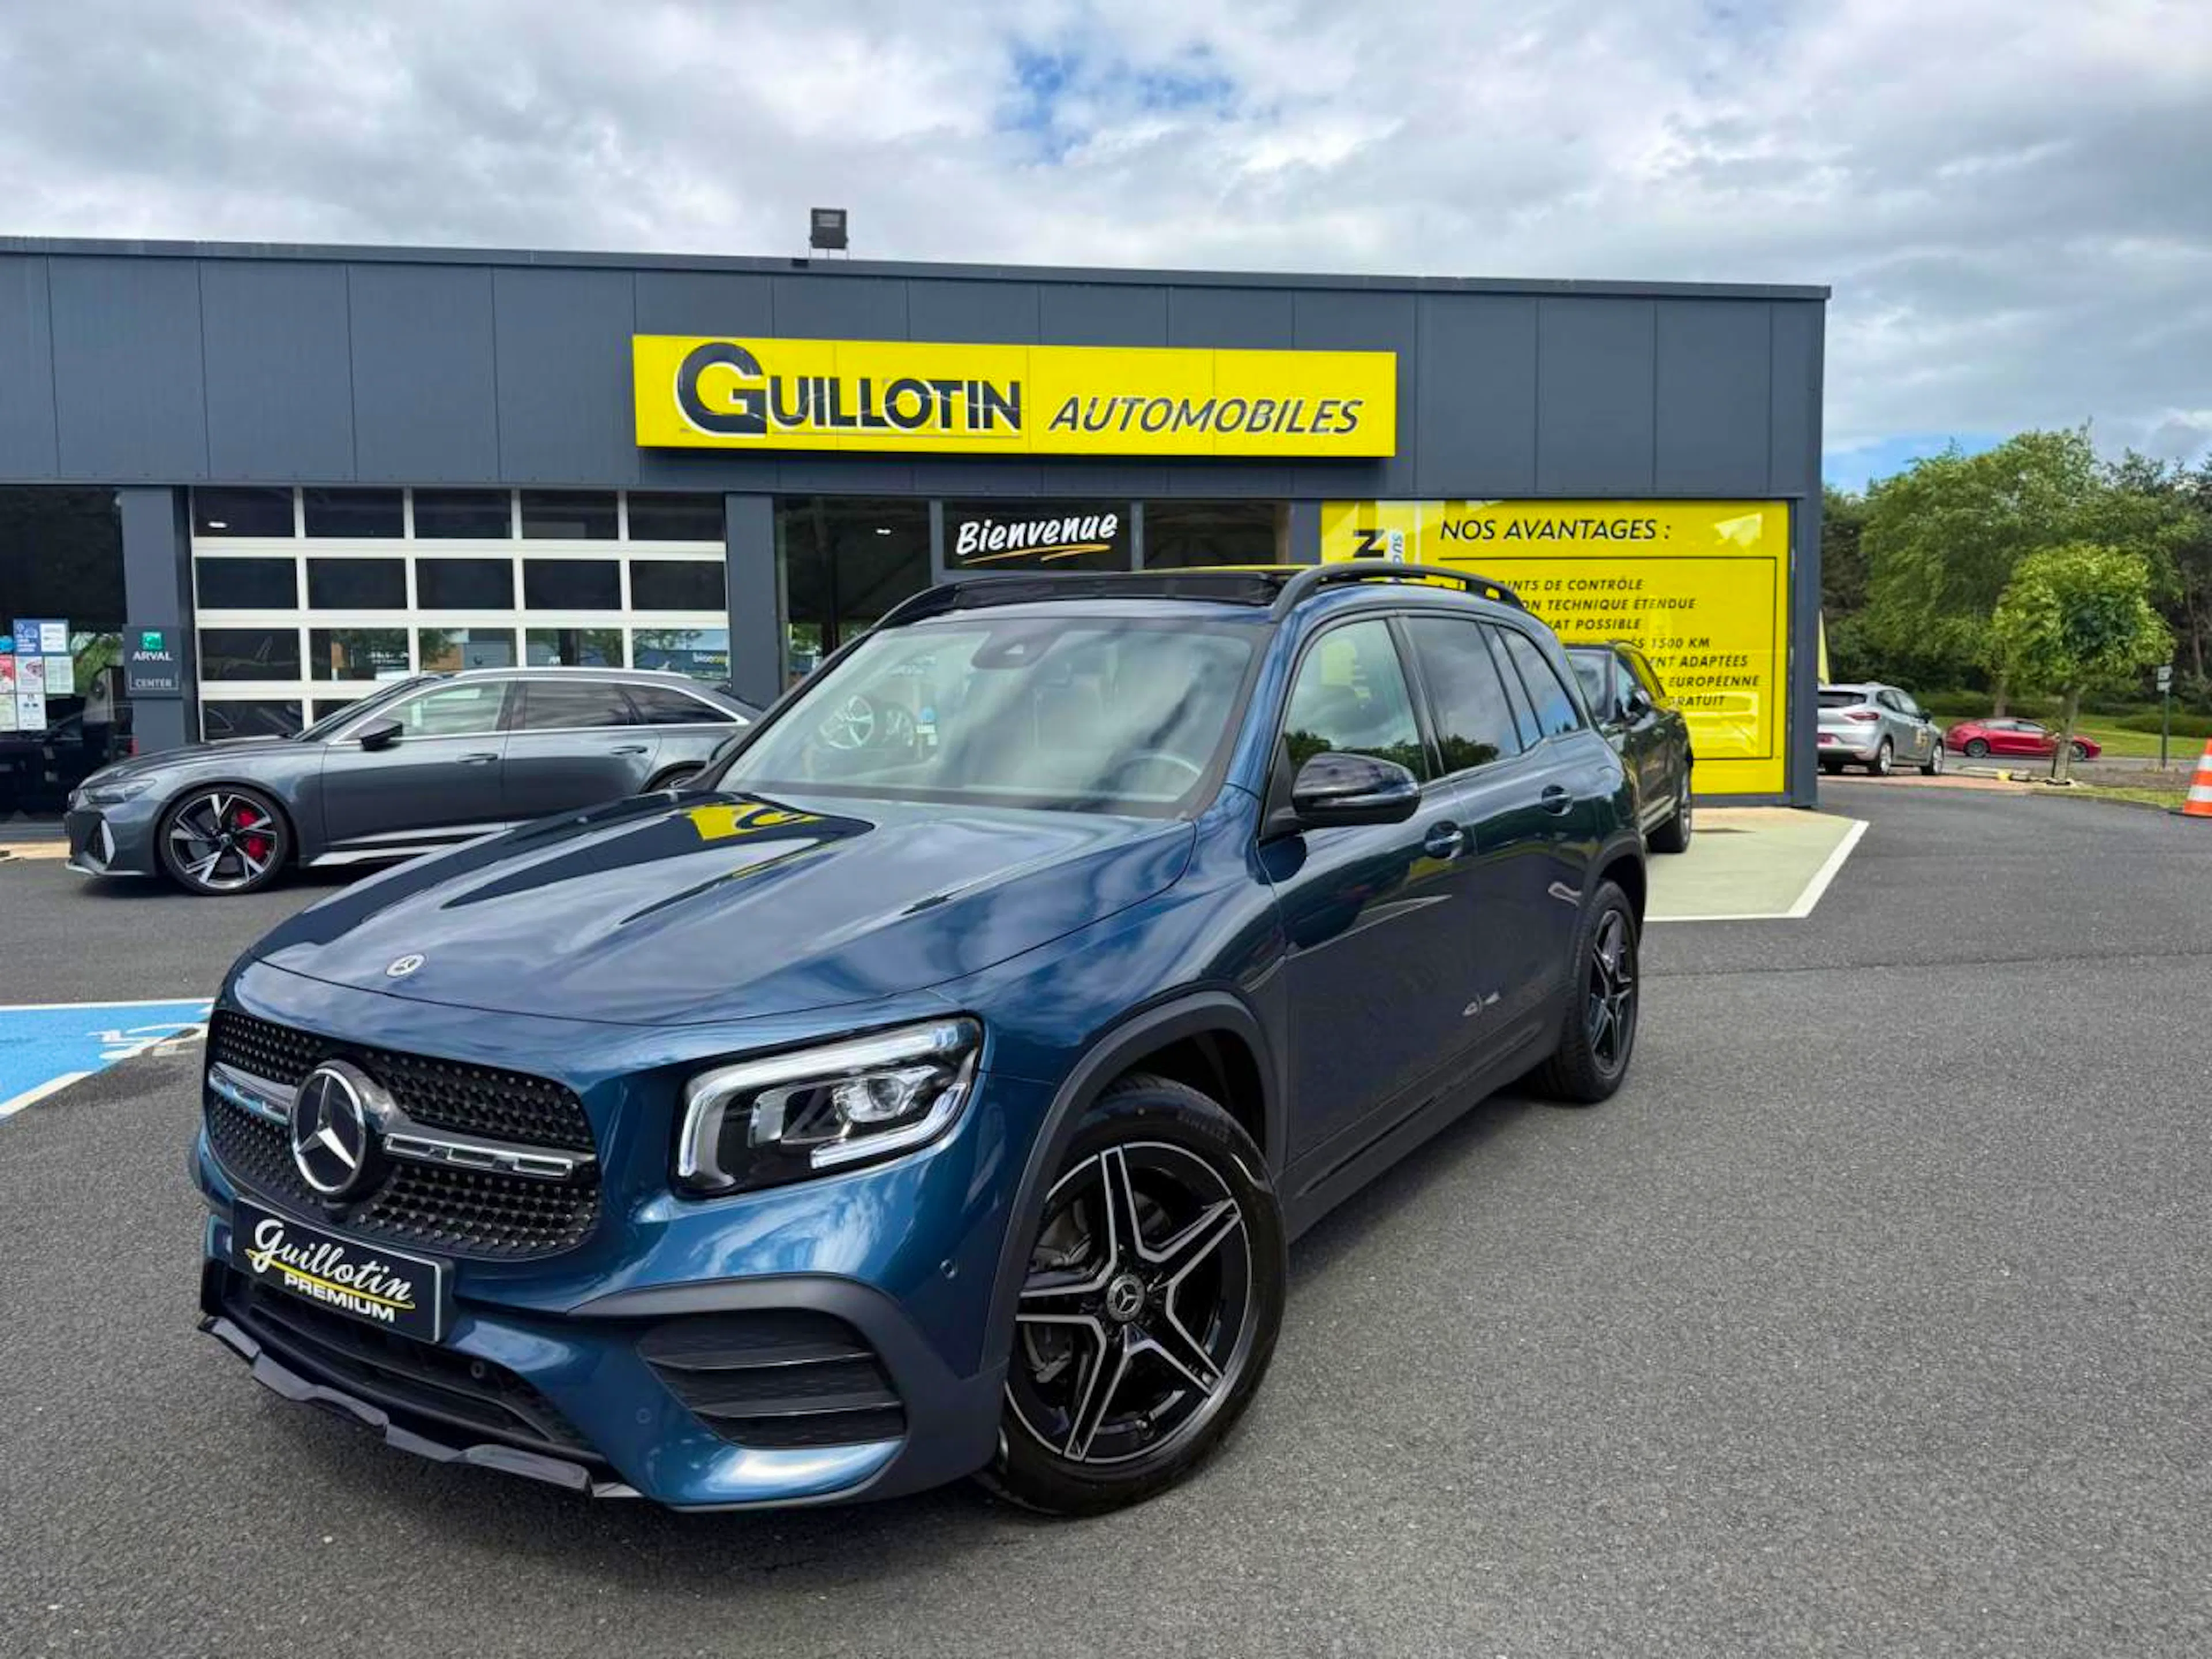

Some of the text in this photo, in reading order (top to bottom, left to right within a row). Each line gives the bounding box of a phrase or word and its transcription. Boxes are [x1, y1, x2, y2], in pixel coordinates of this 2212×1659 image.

[675, 342, 1363, 437] GUILLOTIN AUTOMOBILES
[955, 514, 1119, 556] Bienvenue
[1440, 519, 1497, 540] NOS
[1503, 519, 1657, 540] AVANTAGES
[1545, 581, 1562, 590] DE
[1548, 599, 1628, 611] TECHNIQUE
[1575, 619, 1641, 630] POSSIBLE
[1652, 637, 1684, 649] 1500
[1688, 637, 1710, 649] KM
[132, 651, 173, 661] ARVAL
[135, 678, 172, 687] CENTER
[251, 1219, 413, 1301] Guillotin
[283, 1271, 396, 1324] PREMIUM
